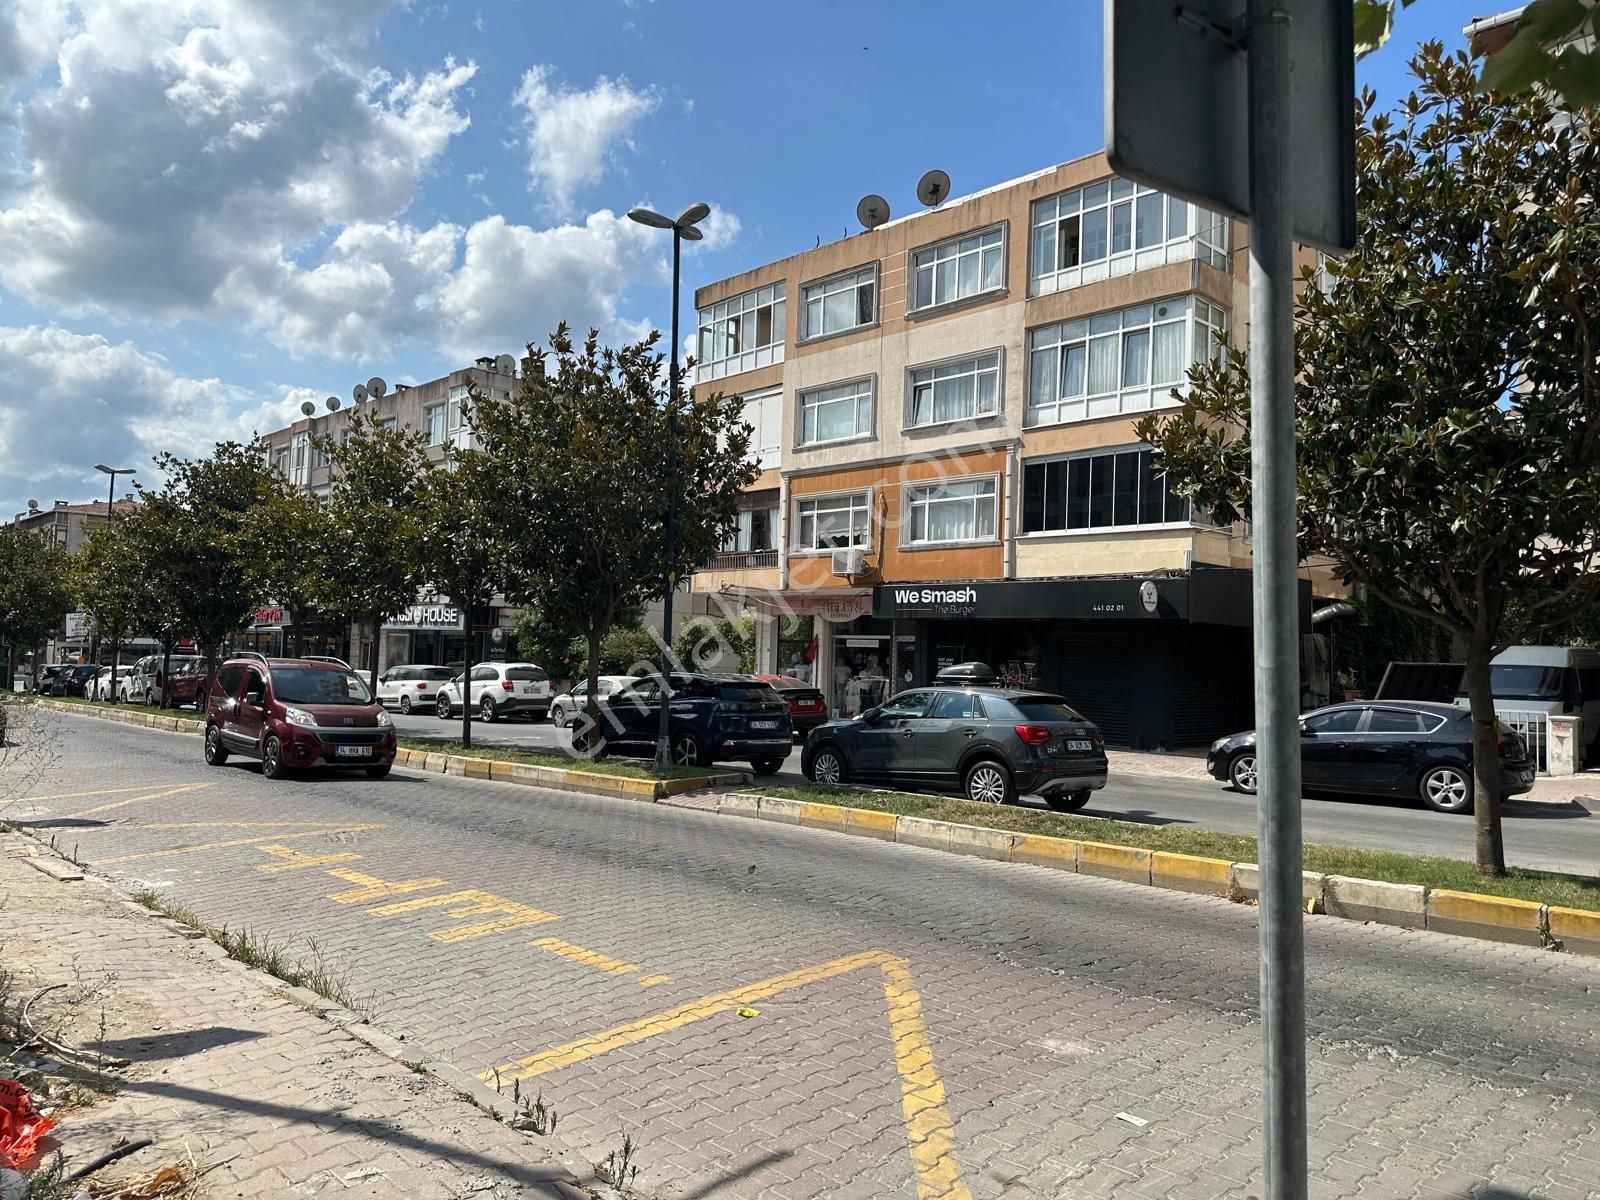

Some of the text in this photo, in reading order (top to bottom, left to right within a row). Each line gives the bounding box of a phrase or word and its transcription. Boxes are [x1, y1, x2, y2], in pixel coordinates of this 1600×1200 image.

[895, 586, 977, 604] We Smash
[422, 607, 458, 622] HOUSE
[935, 604, 976, 616] The Burger
[1092, 604, 1124, 612] 441 02 01
